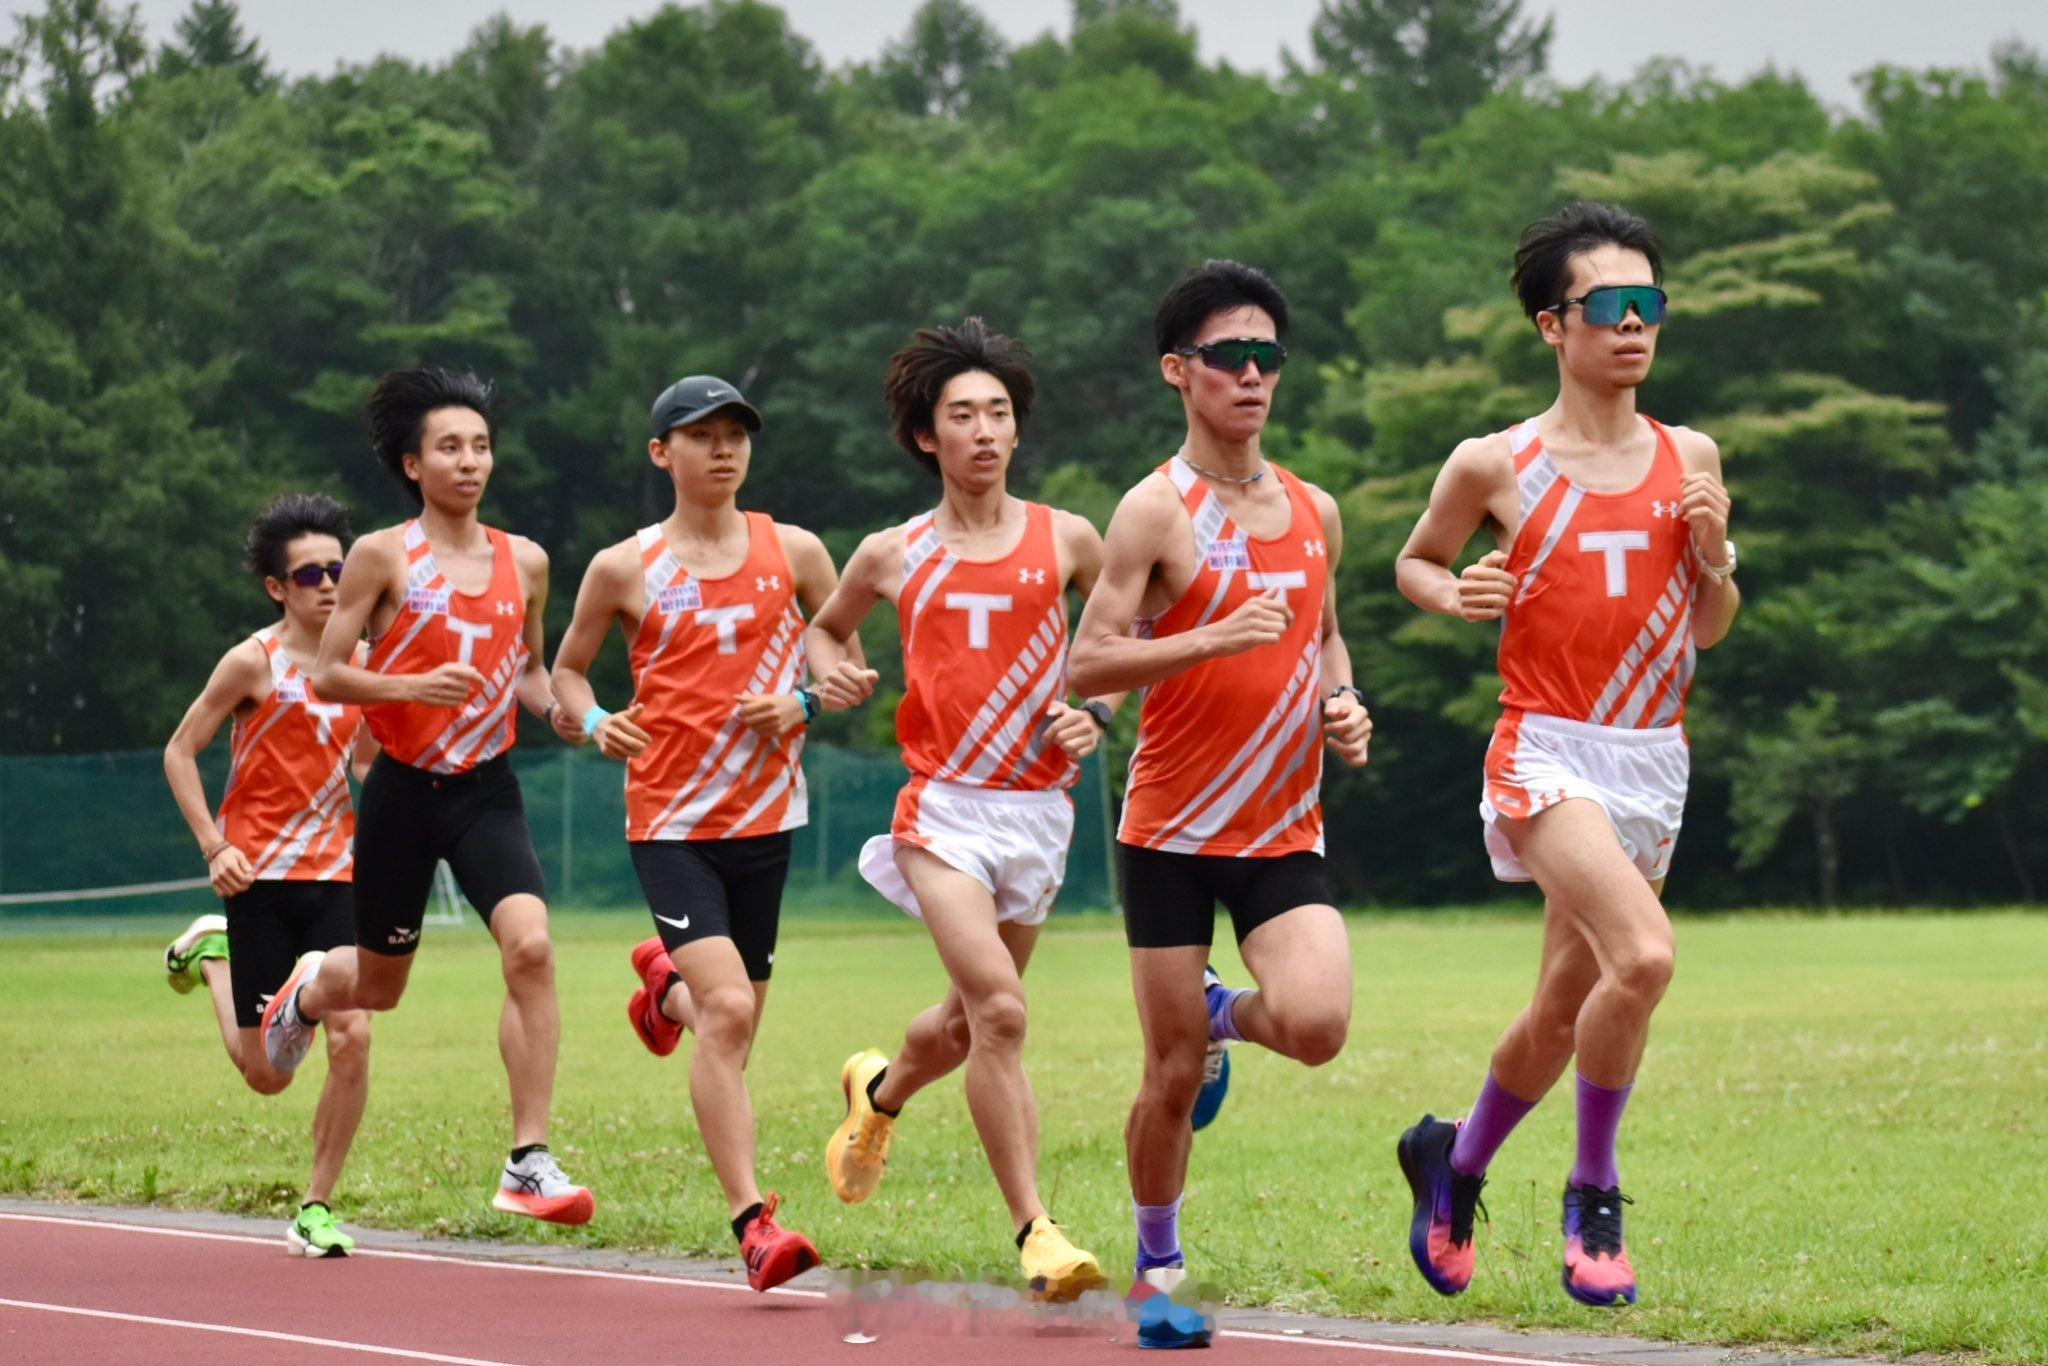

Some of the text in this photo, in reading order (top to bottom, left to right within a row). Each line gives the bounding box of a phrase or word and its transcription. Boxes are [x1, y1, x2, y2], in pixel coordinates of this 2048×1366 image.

[1578, 531, 1649, 597] T
[446, 616, 492, 666] T
[694, 603, 756, 655] T
[945, 593, 1013, 649] T
[306, 703, 344, 745] T
